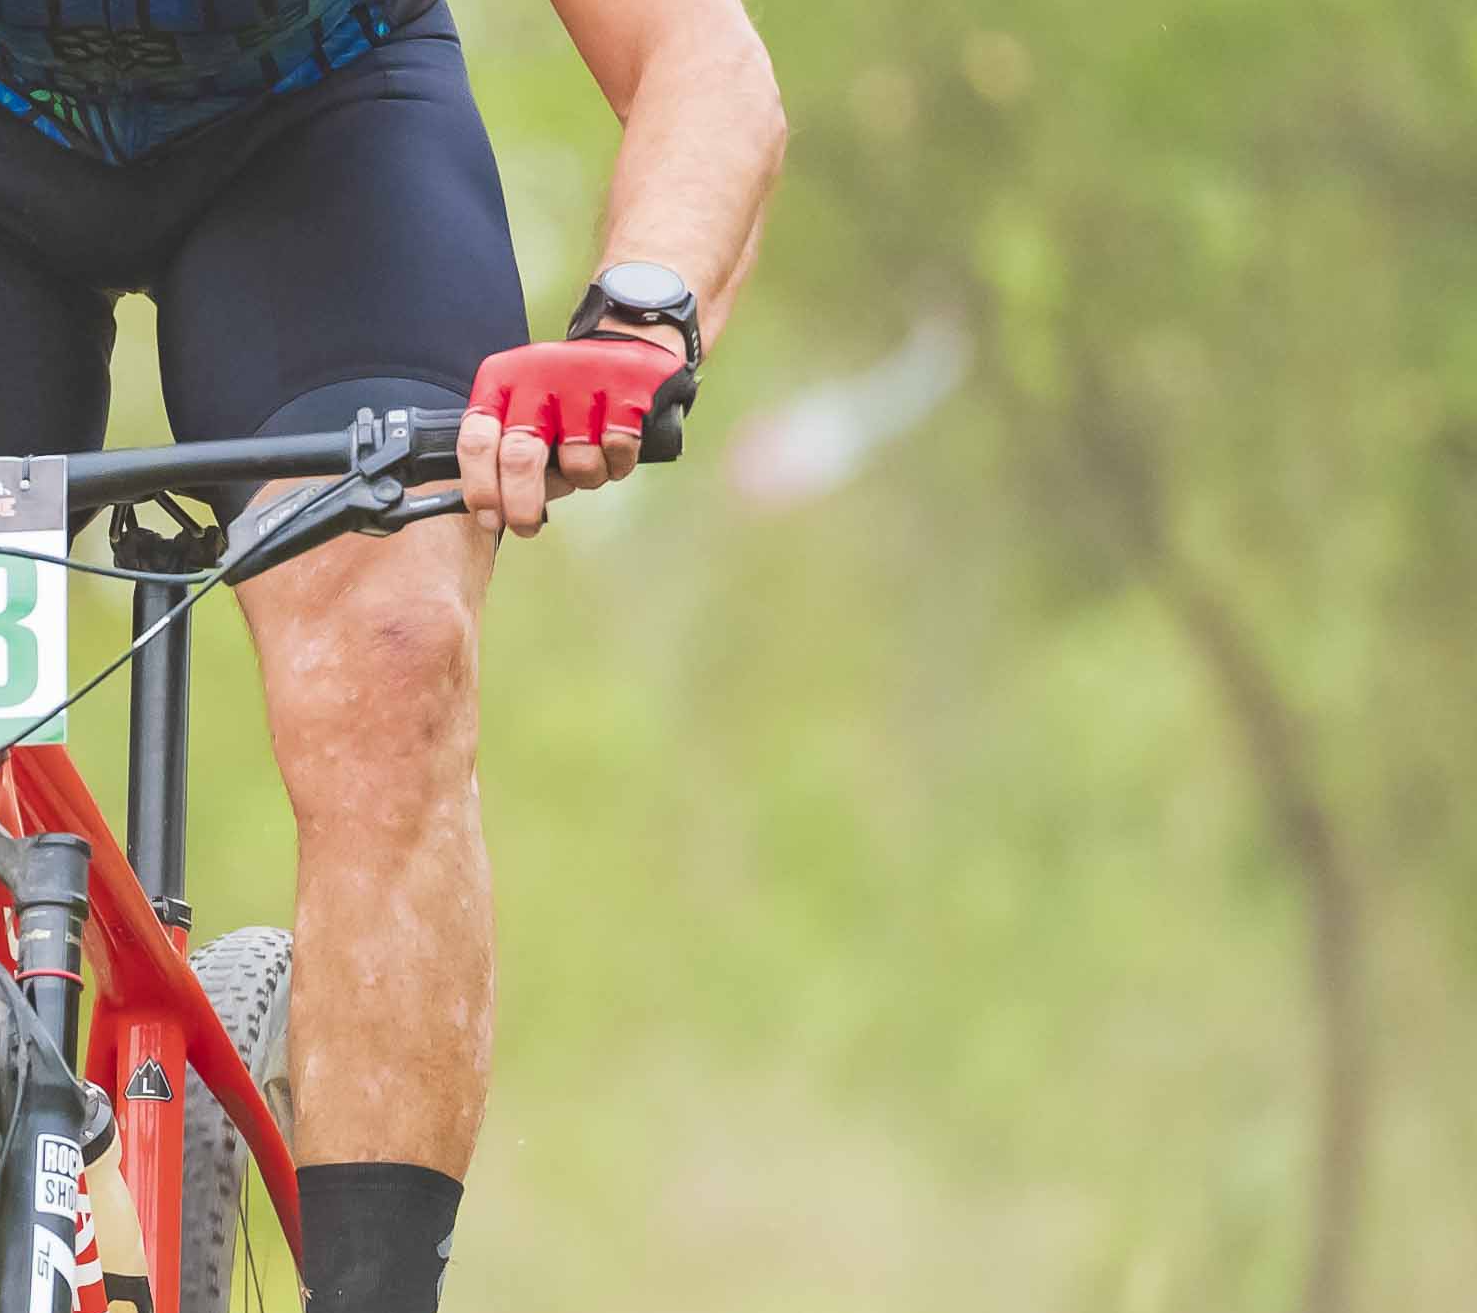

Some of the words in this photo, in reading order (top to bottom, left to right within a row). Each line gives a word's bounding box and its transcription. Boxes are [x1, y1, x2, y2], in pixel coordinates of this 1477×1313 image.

[142, 1077, 156, 1094] L
[42, 1140, 79, 1181] ROC
[45, 1179, 77, 1211] SHO
